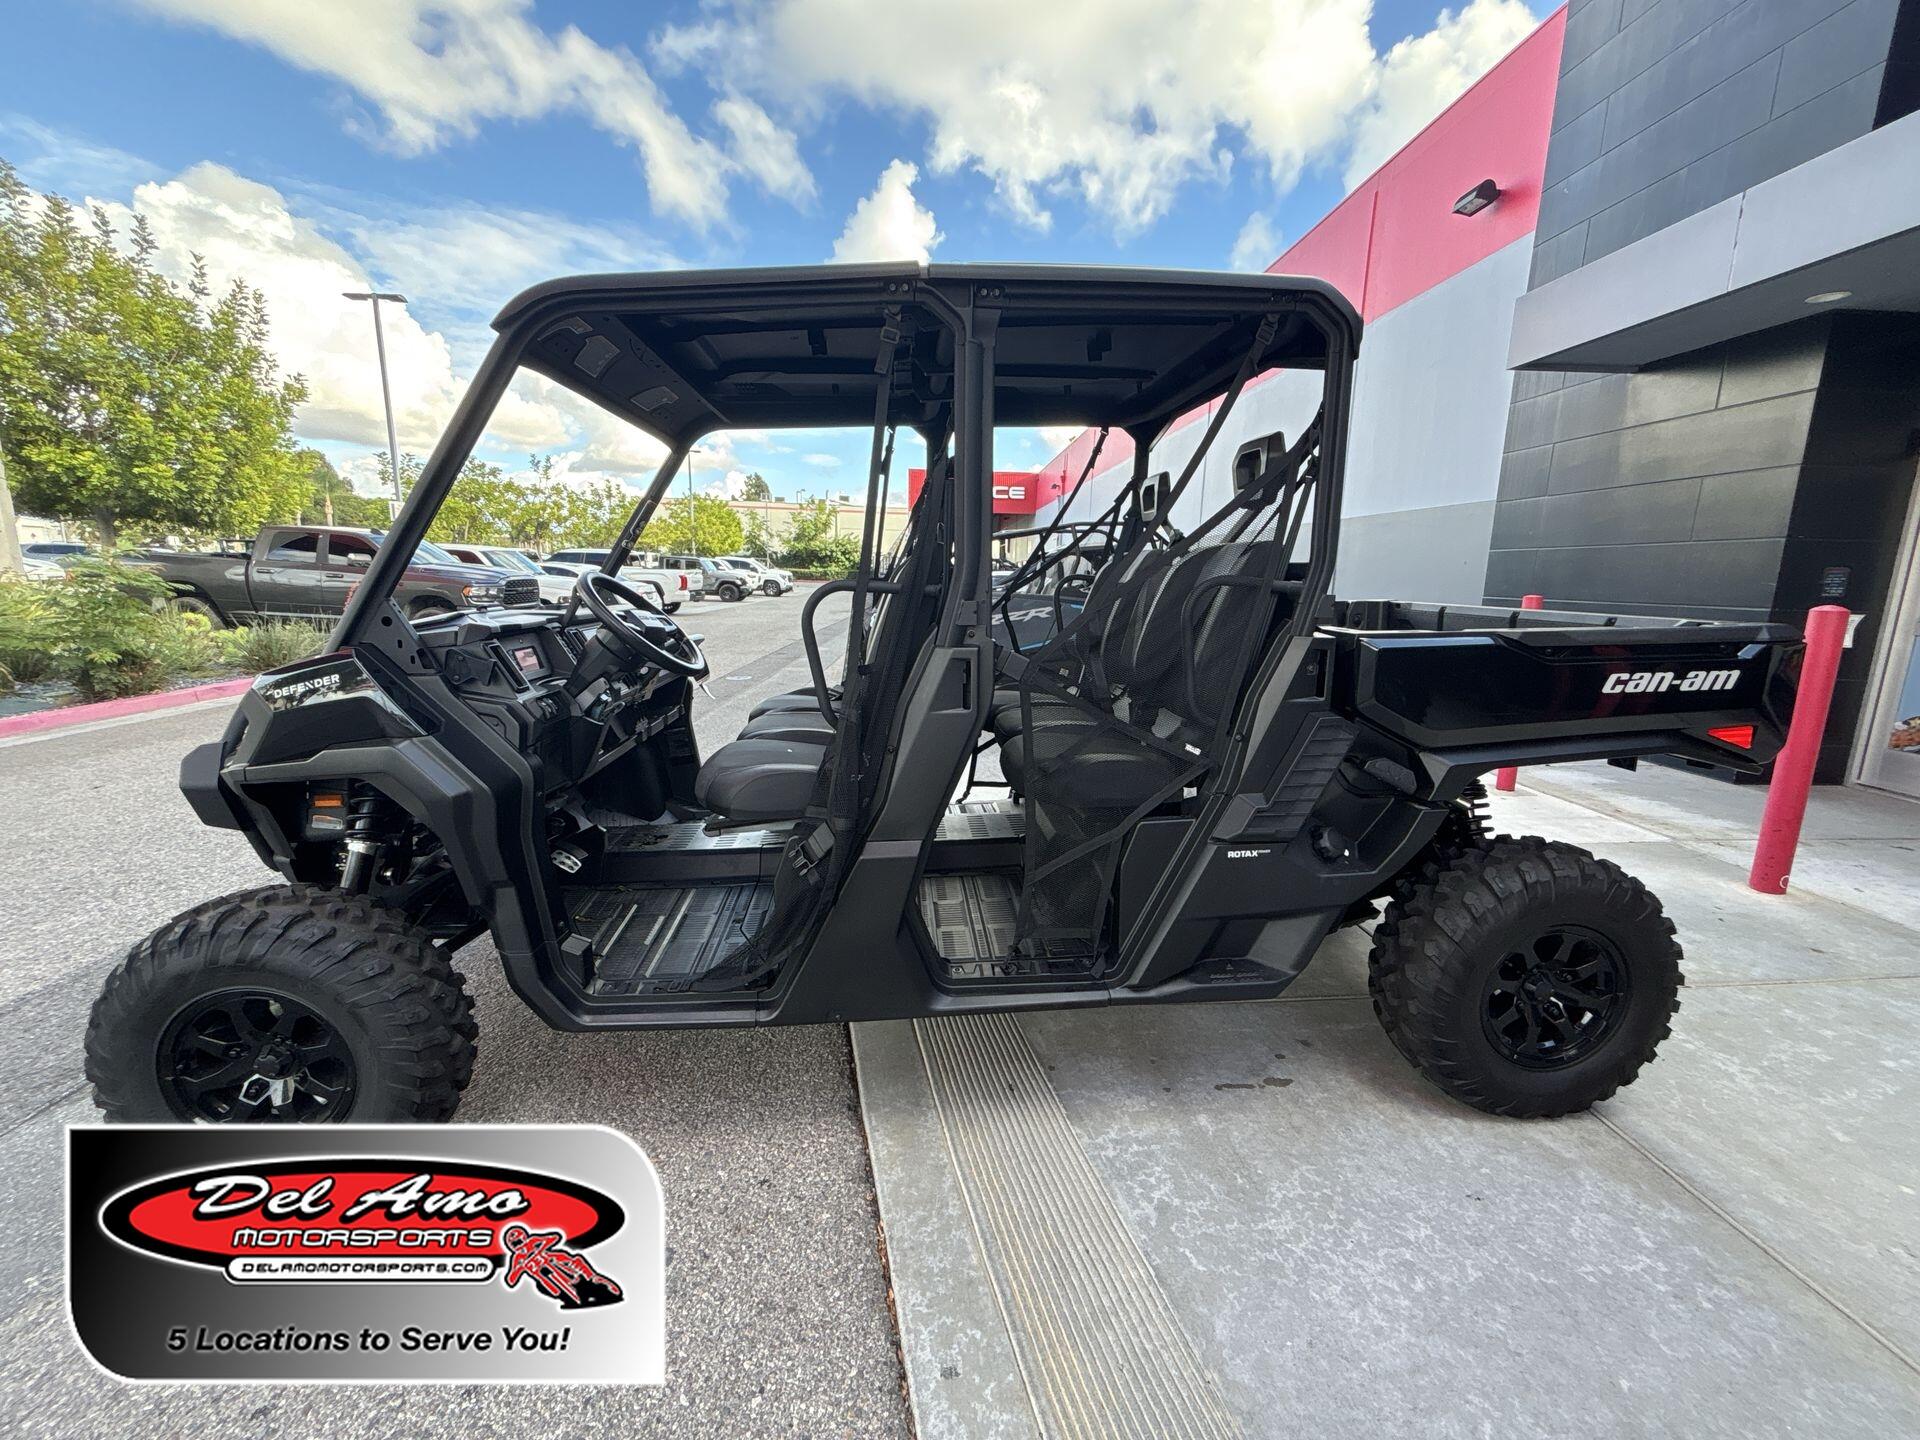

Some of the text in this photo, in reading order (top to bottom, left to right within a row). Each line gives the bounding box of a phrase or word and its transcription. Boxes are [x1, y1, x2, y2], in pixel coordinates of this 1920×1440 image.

[274, 674, 340, 698] DEFENDER
[1601, 669, 1740, 693] can-am
[1227, 849, 1258, 858] ROTAX
